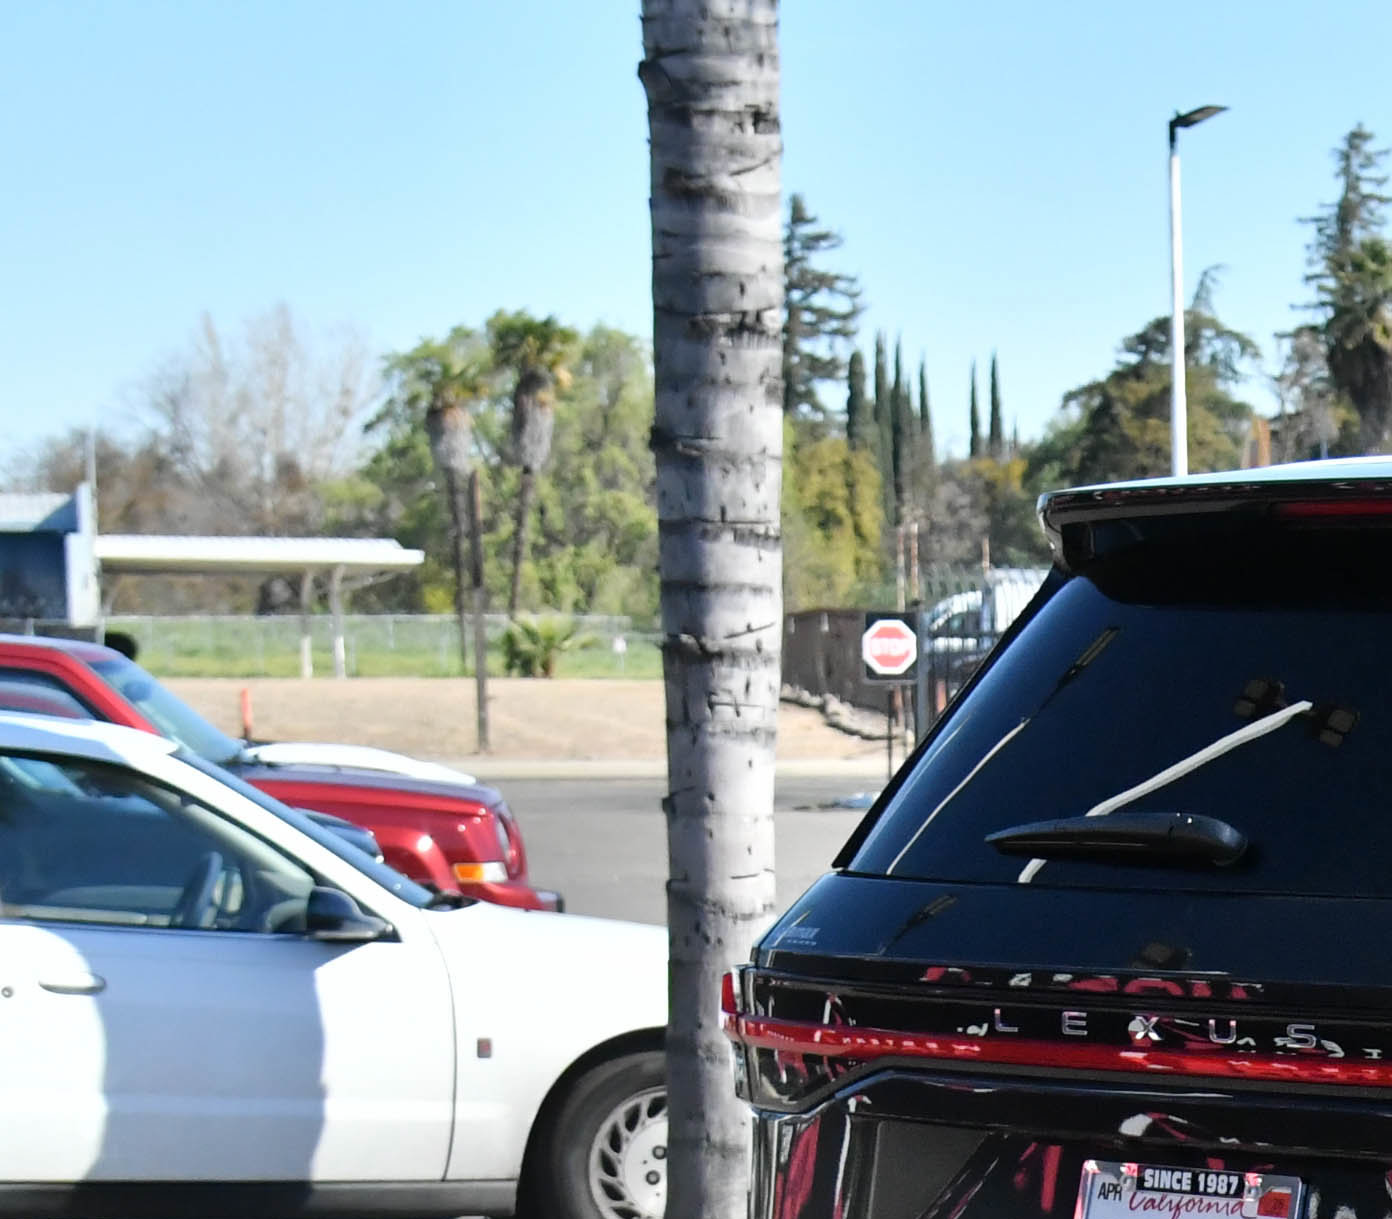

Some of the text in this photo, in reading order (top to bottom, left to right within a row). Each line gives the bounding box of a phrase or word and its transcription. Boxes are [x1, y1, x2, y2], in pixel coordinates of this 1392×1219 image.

[995, 1008, 1317, 1048] LEXUS
[1097, 1182, 1122, 1201] APR
[1143, 1168, 1239, 1196] SINCE 1987
